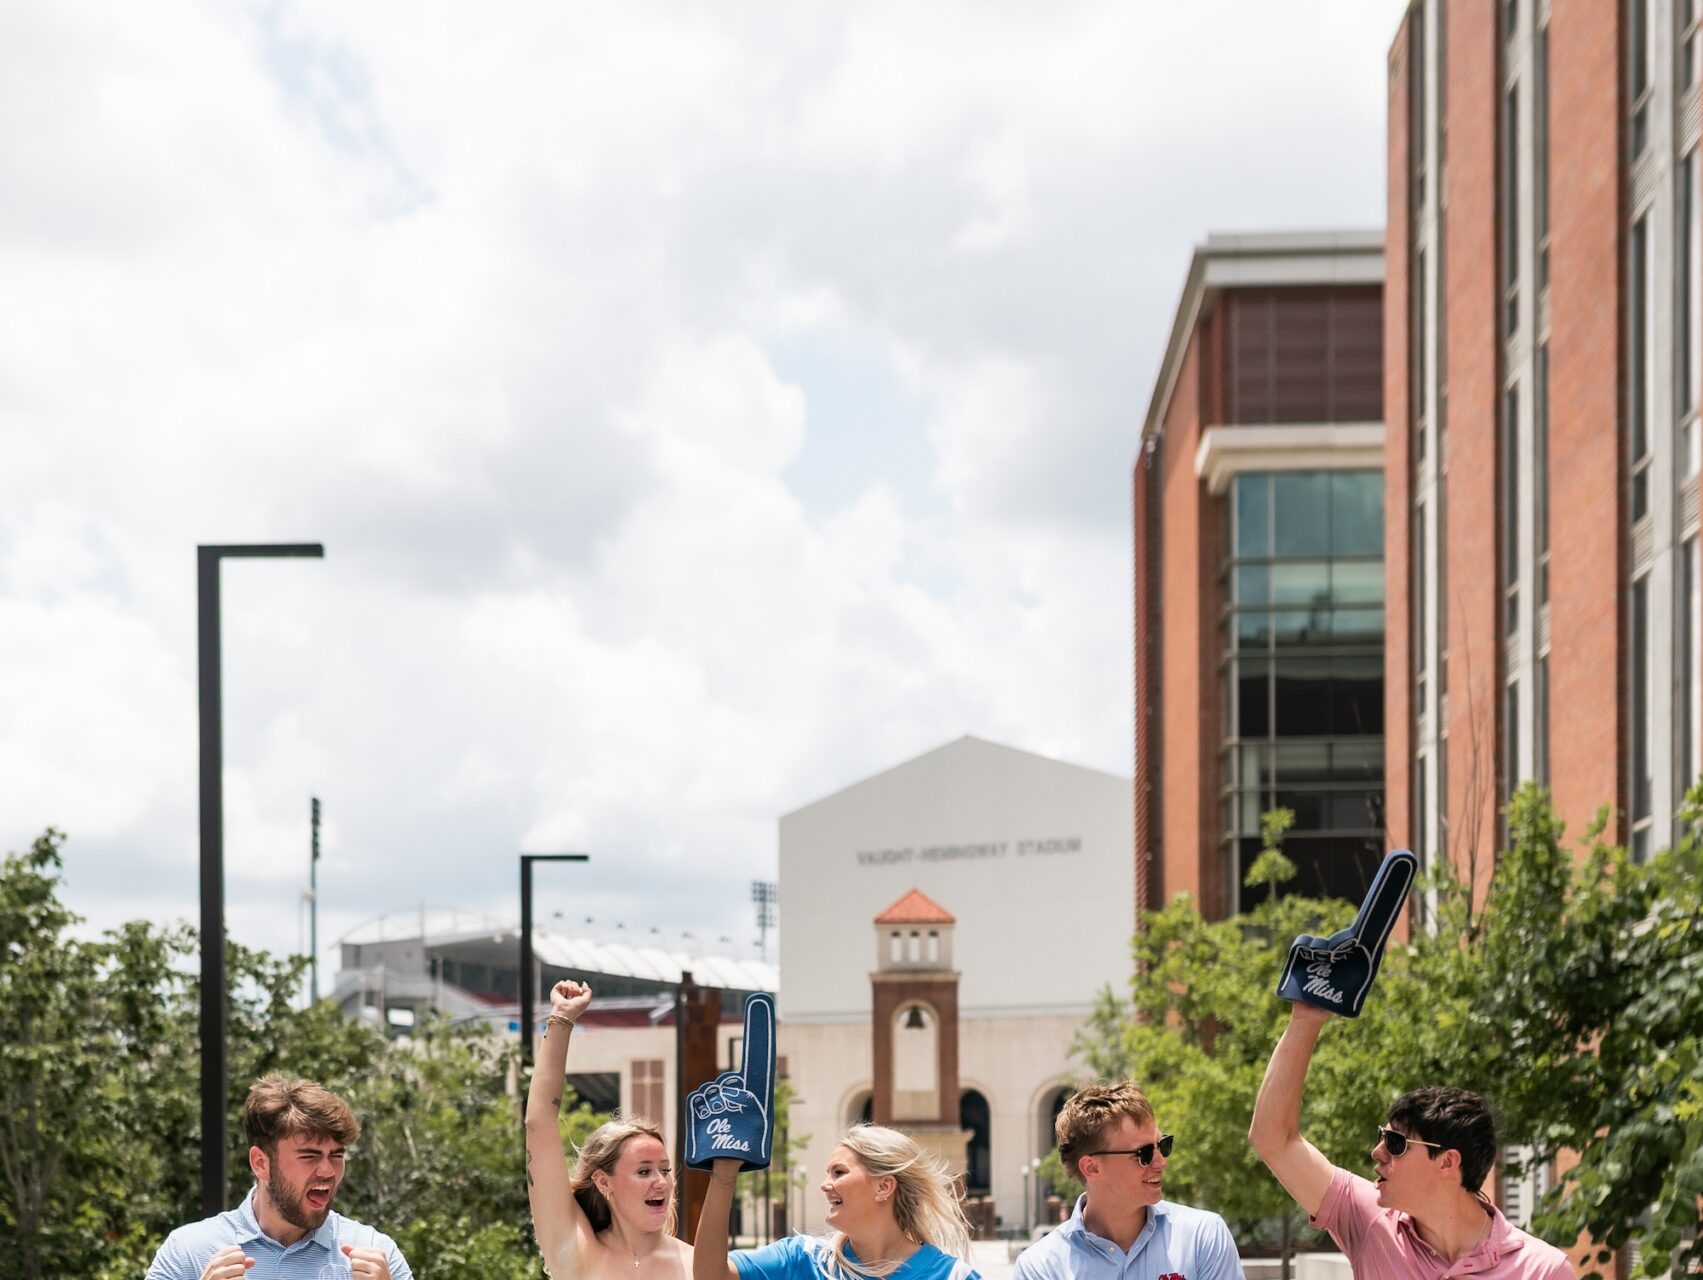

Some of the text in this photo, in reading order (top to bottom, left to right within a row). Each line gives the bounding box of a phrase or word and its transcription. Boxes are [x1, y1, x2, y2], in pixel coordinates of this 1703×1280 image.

[1016, 837, 1082, 856] STADIUM
[1306, 961, 1332, 977] Ole
[1303, 975, 1343, 1003] Miss
[706, 1118, 731, 1134] Ole
[711, 1134, 751, 1152] Miss
